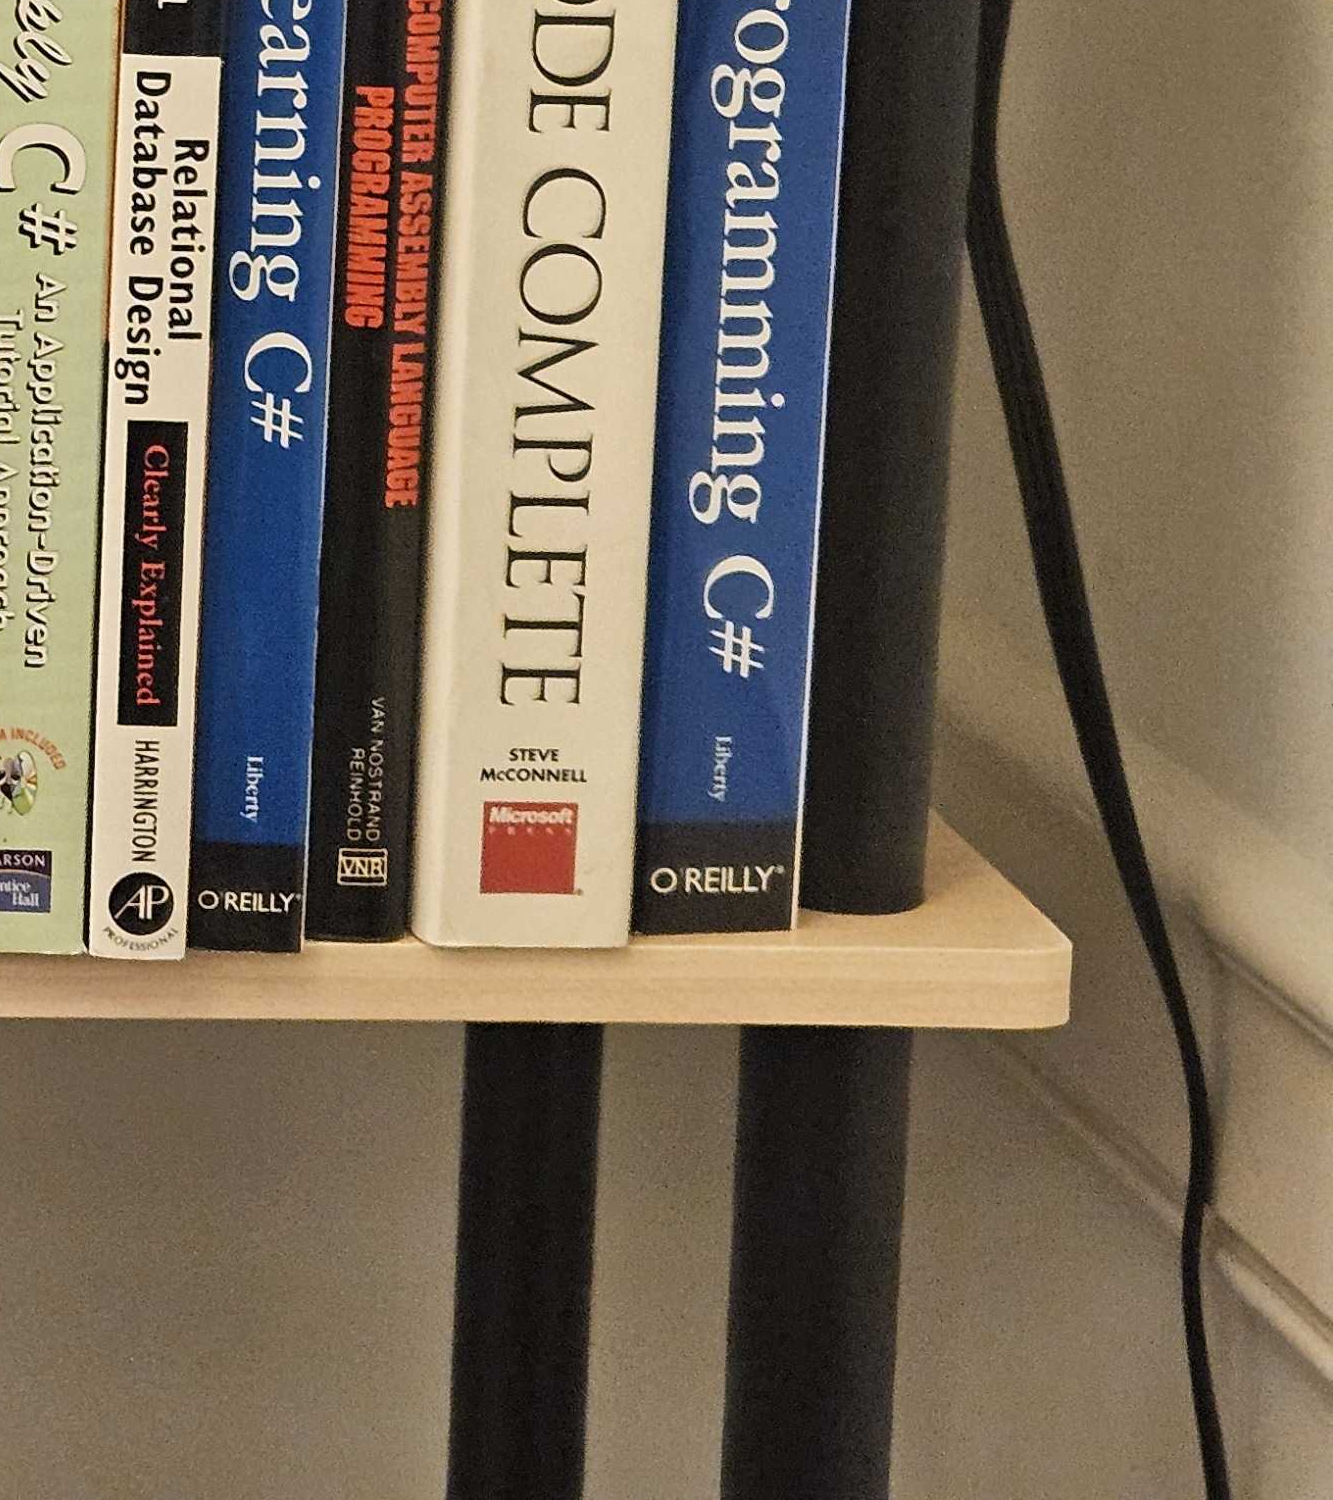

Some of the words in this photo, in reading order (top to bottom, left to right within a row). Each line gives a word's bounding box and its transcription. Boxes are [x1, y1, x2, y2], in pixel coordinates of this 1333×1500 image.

[130, 72, 171, 255] Database
[345, 86, 394, 328] PROGRAMMING
[169, 140, 209, 339] Relational
[394, 171, 432, 334] ASSEMBLY
[115, 276, 163, 404] Design
[245, 332, 312, 448] C#
[385, 343, 425, 508] LANGUAGE
[500, 168, 606, 705] COMPLETE
[704, 555, 774, 678] C#
[132, 740, 159, 861] HARRINGTON
[481, 768, 587, 782] McCONNELL
[510, 748, 558, 761] STEVE
